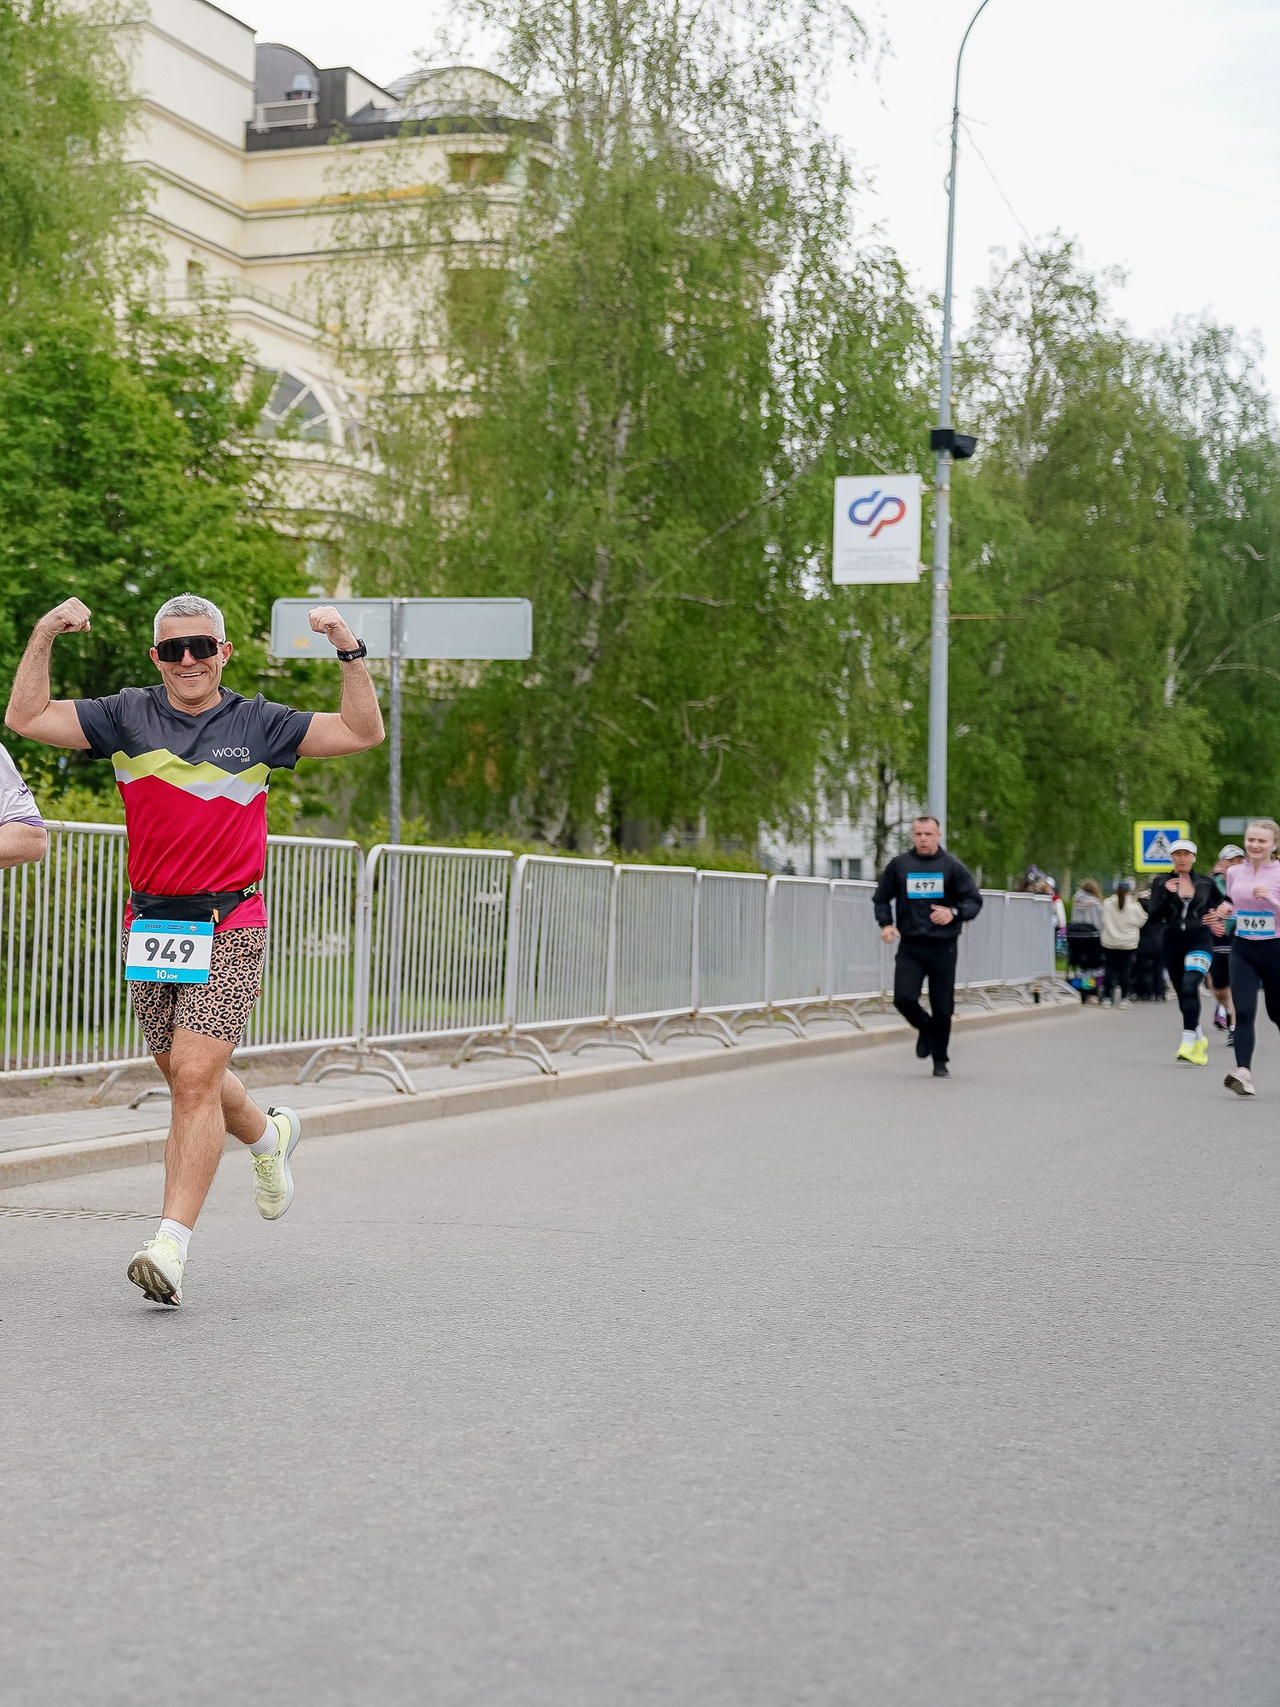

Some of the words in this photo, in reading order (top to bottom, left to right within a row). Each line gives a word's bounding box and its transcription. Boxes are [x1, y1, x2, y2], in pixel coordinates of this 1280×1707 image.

[212, 747, 250, 758] WOOD
[915, 881, 935, 891] 697
[1243, 918, 1266, 929] 969
[145, 938, 195, 963] 949
[156, 970, 166, 979] 10
